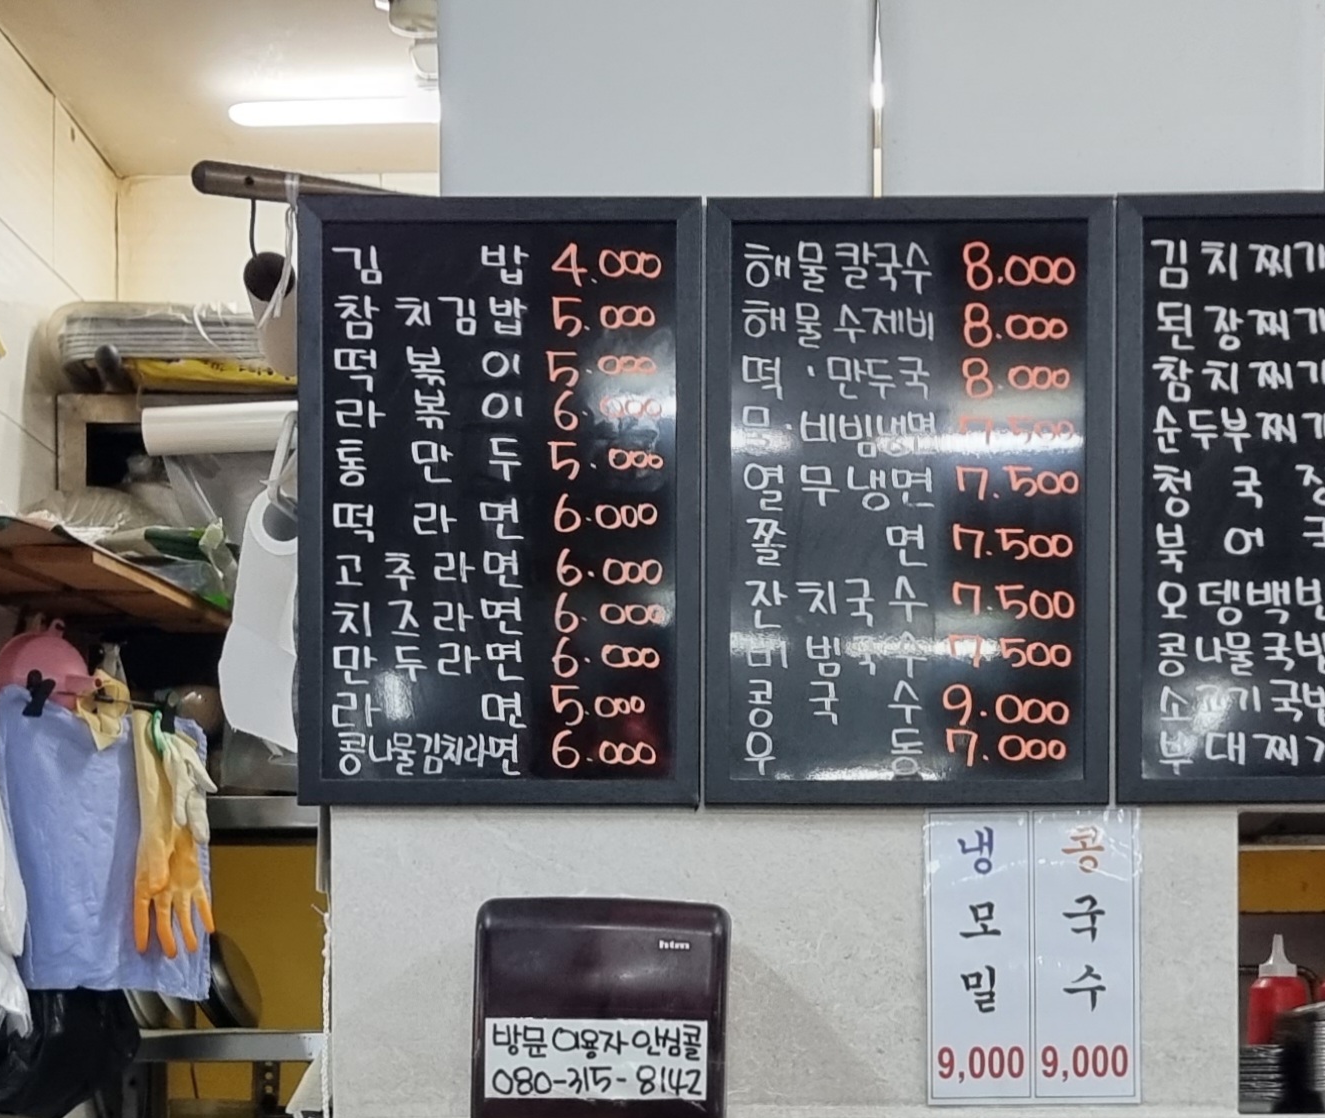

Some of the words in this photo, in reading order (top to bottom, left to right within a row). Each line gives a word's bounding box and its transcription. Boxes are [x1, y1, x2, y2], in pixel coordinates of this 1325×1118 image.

[744, 241, 932, 292] 해물칼국수
[334, 296, 526, 340] 참치김밥
[742, 300, 934, 348] 해물수제비
[957, 415, 1075, 446] 7500
[743, 463, 935, 511] 열무냉면
[334, 550, 524, 588] 고추라면
[332, 598, 524, 638] 치즈라면
[745, 575, 928, 629] 잔치국수
[332, 639, 524, 684] 만두라면
[948, 634, 1072, 668] 7500
[338, 732, 521, 776] 콩나물김치라면
[493, 1023, 548, 1058] 방문
[552, 1027, 629, 1060] 이용자
[937, 1046, 1025, 1084] 9,000
[1041, 1045, 1129, 1083] 9,000
